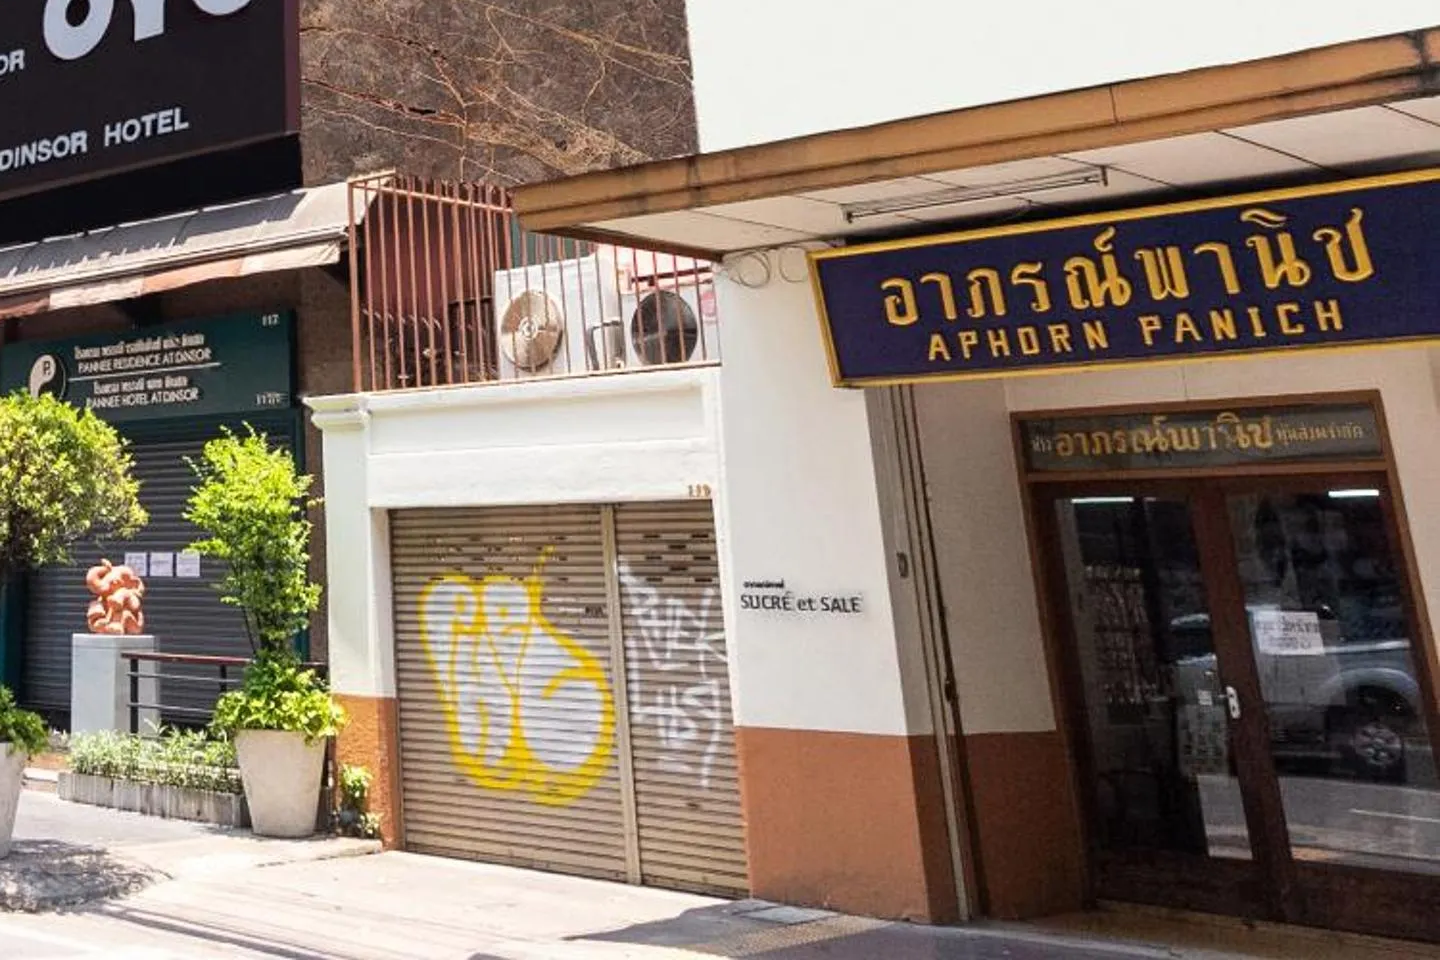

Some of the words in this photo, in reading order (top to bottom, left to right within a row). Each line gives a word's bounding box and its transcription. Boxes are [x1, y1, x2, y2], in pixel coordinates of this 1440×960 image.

[103, 107, 190, 147] HOTEL
[880, 207, 1375, 326] อาภรณ์พานิช
[928, 320, 1109, 362] APHORN
[1138, 299, 1344, 346] PANICH
[78, 358, 112, 374] PANNEE
[113, 353, 161, 370] RESIDENCE
[796, 597, 818, 612] et
